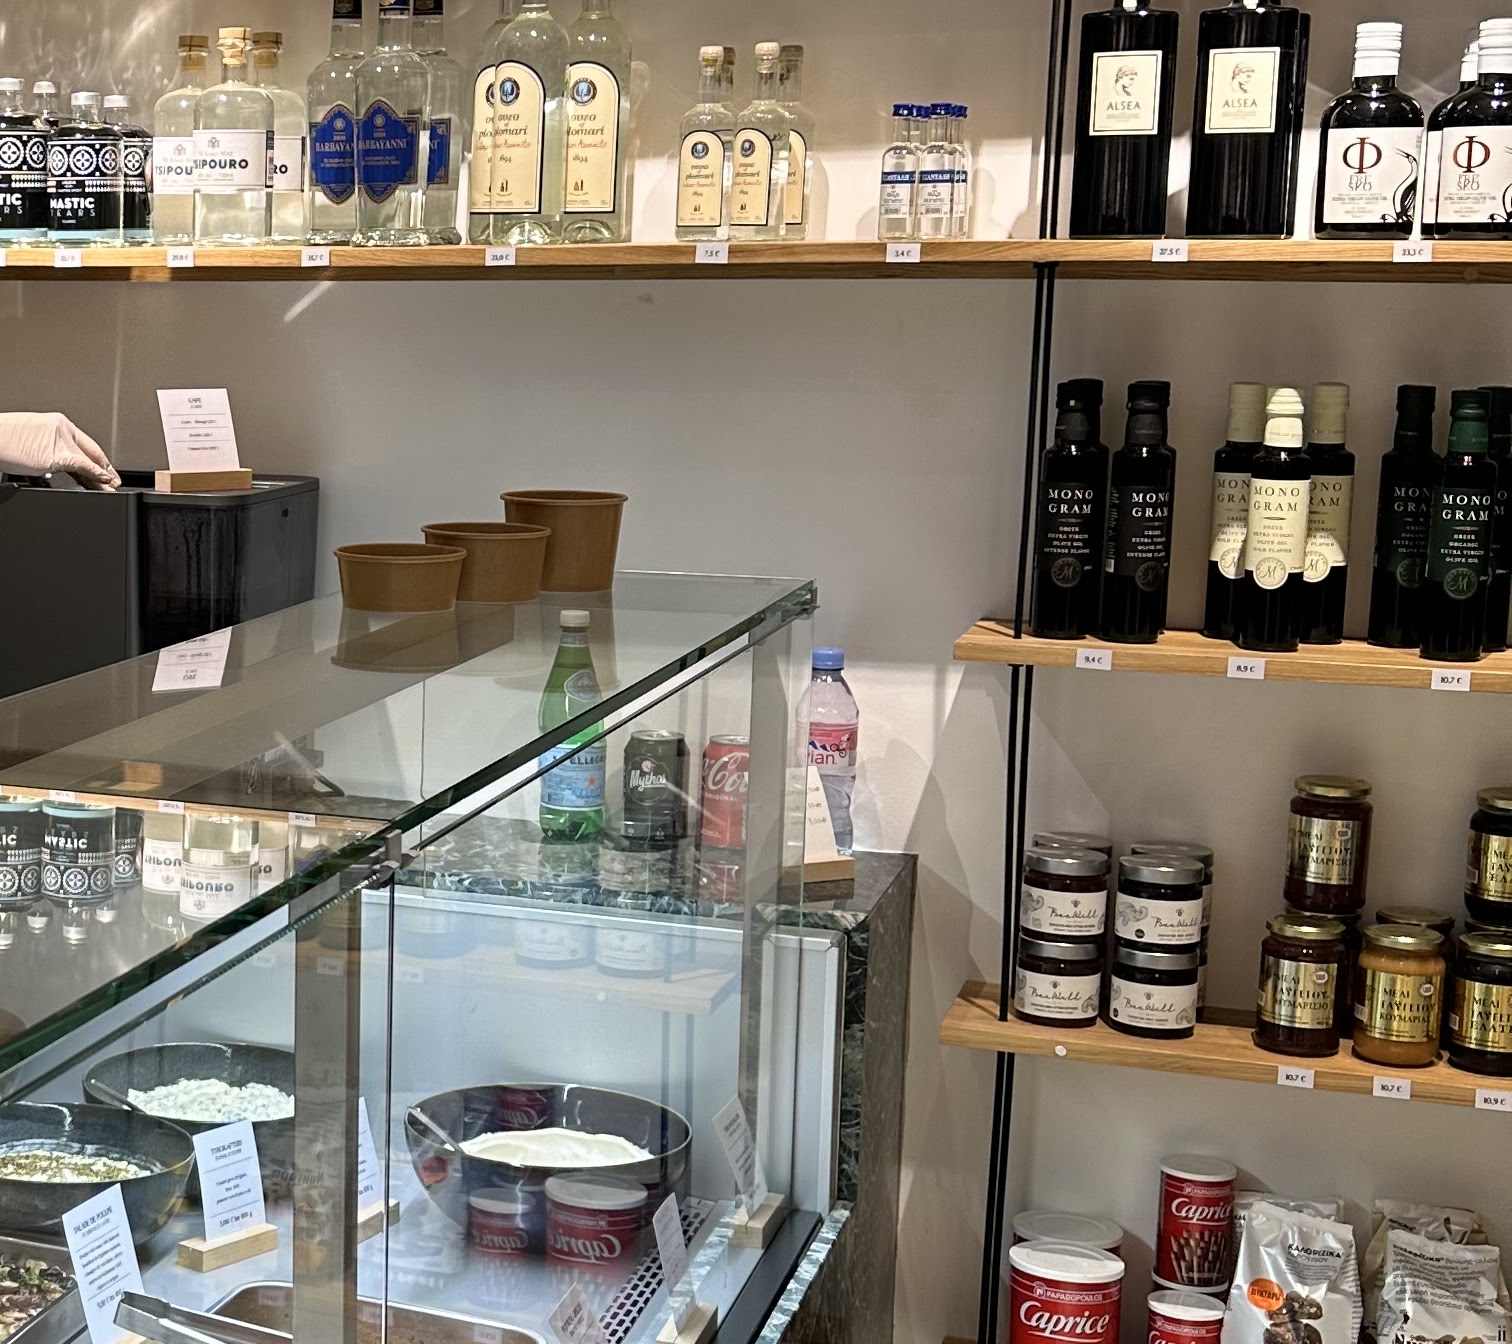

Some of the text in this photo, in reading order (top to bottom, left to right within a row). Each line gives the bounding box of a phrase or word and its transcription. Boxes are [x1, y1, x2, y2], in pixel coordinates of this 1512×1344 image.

[1106, 101, 1141, 111] ALSEA
[1223, 99, 1258, 109] ALSEA
[315, 138, 354, 154] BARBAYAN
[155, 165, 193, 176] TSIPOU
[50, 197, 95, 209] MASTIC
[1217, 479, 1249, 489] MON
[1048, 489, 1093, 499] MONO
[1254, 485, 1300, 497] MONO
[1217, 495, 1247, 503] GRA
[1442, 494, 1491, 505] MONO
[1048, 503, 1092, 514] GRAM
[1254, 500, 1298, 511] GRAM
[1442, 509, 1489, 521] GRAM
[804, 750, 837, 766] vian
[1020, 1301, 1110, 1335] Caprice
